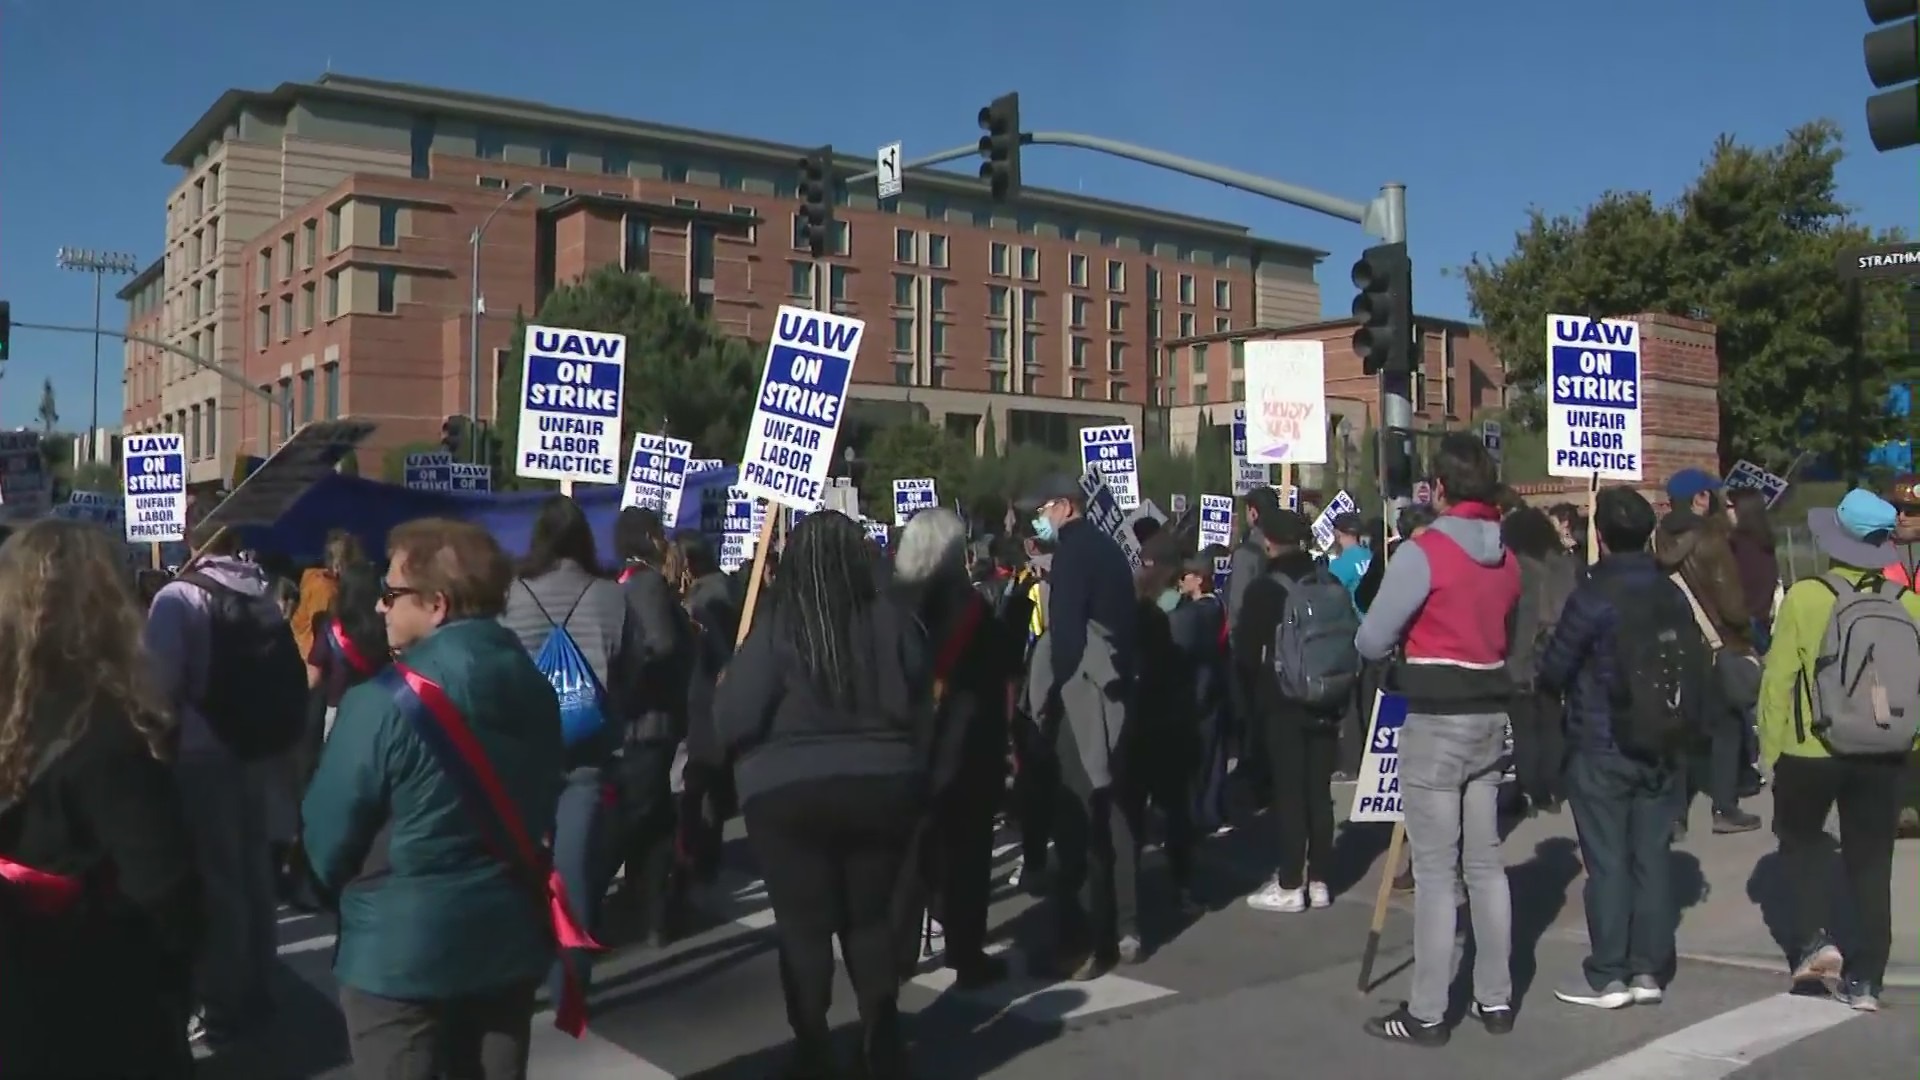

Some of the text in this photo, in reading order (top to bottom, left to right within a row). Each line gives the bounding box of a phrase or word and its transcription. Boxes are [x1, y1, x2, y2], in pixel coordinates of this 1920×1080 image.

[778, 313, 859, 351] UAW
[1556, 319, 1633, 345] UAW
[535, 331, 620, 358] UAW
[557, 361, 592, 384] ON
[790, 355, 823, 385] ON
[1579, 351, 1612, 375] ON
[529, 383, 617, 410] STRIKE
[1556, 375, 1635, 402] STRIKE
[763, 380, 839, 422] STRIKE
[539, 416, 604, 435] UNFAIR
[1567, 410, 1625, 429] UNFAIR
[763, 418, 821, 450] UNFAIR
[1083, 429, 1131, 443] UAW
[1570, 431, 1623, 449] LABOR
[128, 437, 180, 453] UAW
[541, 435, 599, 454] LABOR
[640, 437, 688, 455] UAW
[1099, 446, 1119, 458] ON
[143, 457, 165, 473] ON
[406, 455, 449, 465] UAW
[525, 453, 613, 475] PRACTICE
[760, 442, 812, 473] LABOR
[1557, 450, 1637, 470] PRACTICE
[420, 469, 437, 480] ON
[451, 466, 488, 476] UAW
[1740, 463, 1782, 487] UAW
[129, 474, 181, 491] STRIKE
[460, 480, 476, 488] ON
[744, 462, 820, 501] PRACTICE
[897, 481, 931, 489] UAW
[136, 497, 176, 509] UNFAIR
[906, 492, 921, 501] ON
[1202, 498, 1231, 508] UAW
[138, 510, 174, 522] LABOR
[130, 523, 184, 536] PRACTICE
